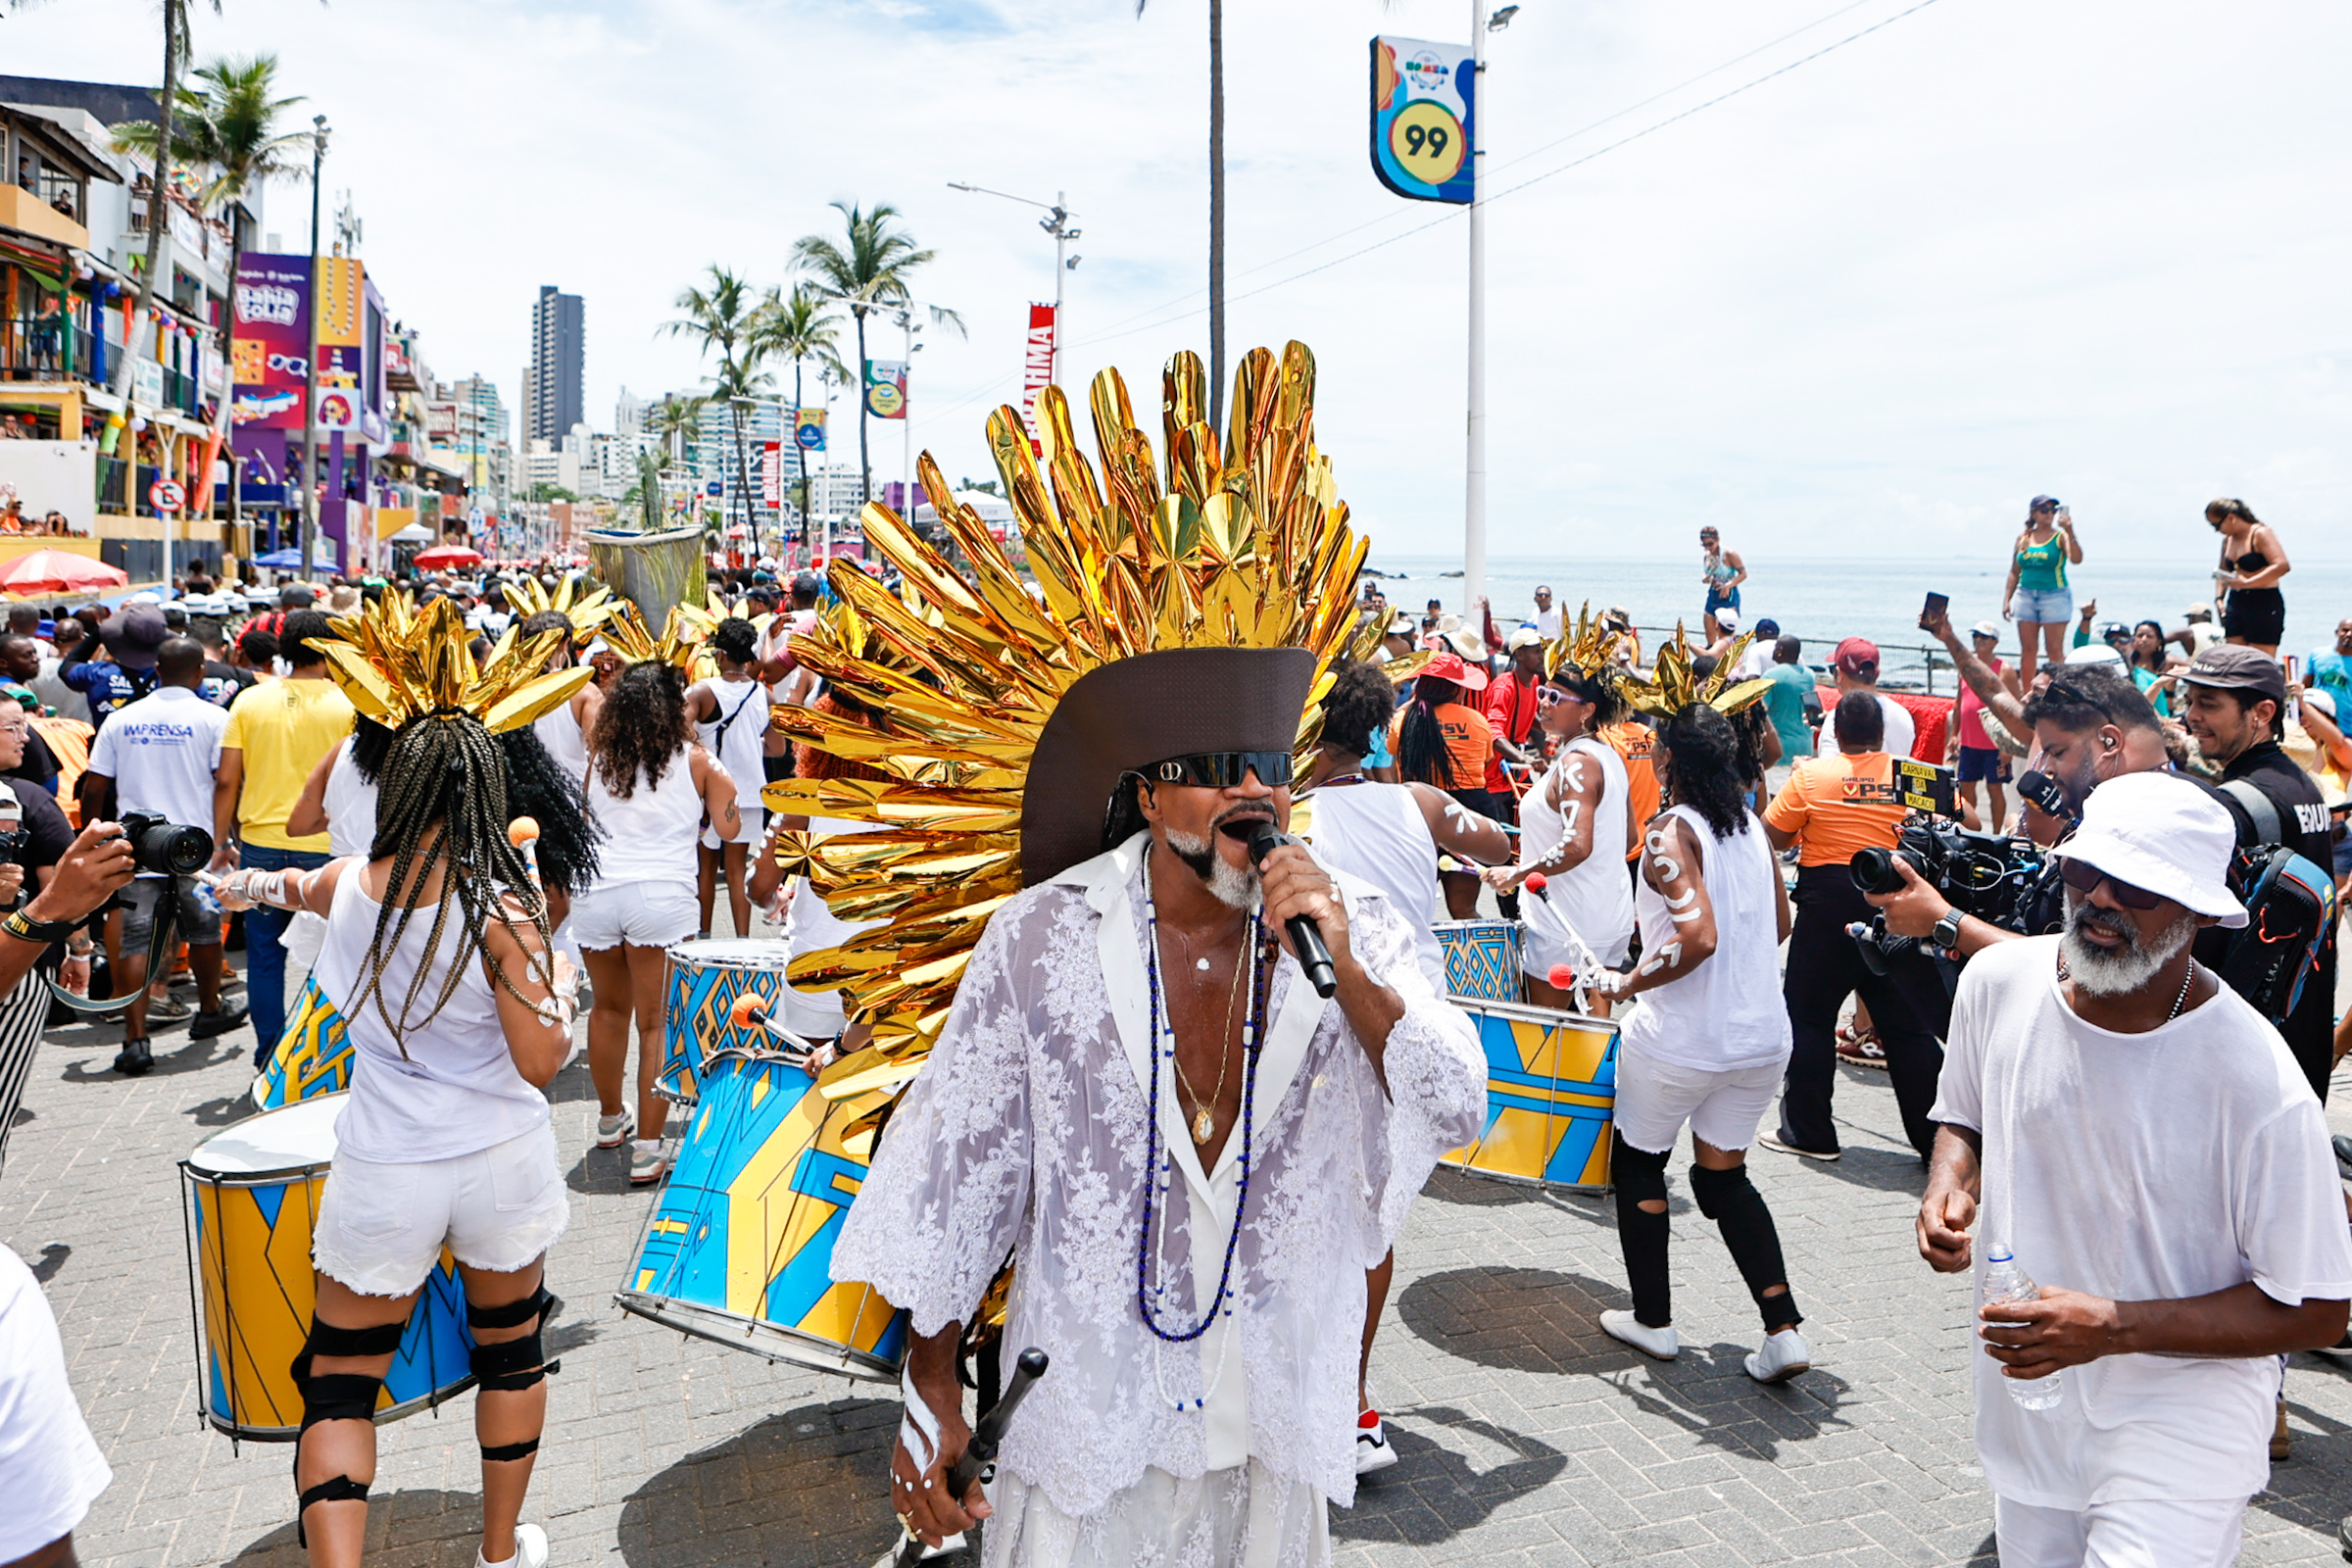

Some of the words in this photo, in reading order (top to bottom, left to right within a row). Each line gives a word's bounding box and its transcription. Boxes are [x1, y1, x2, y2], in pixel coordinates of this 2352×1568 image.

[1405, 123, 1448, 159] 99
[762, 450, 780, 501] BRAHMA
[124, 724, 193, 737] IMPRENSA
[1902, 764, 1936, 779] CARNAVAL
[1908, 795, 1936, 810] MACACO
[2294, 804, 2331, 834] EQUI
